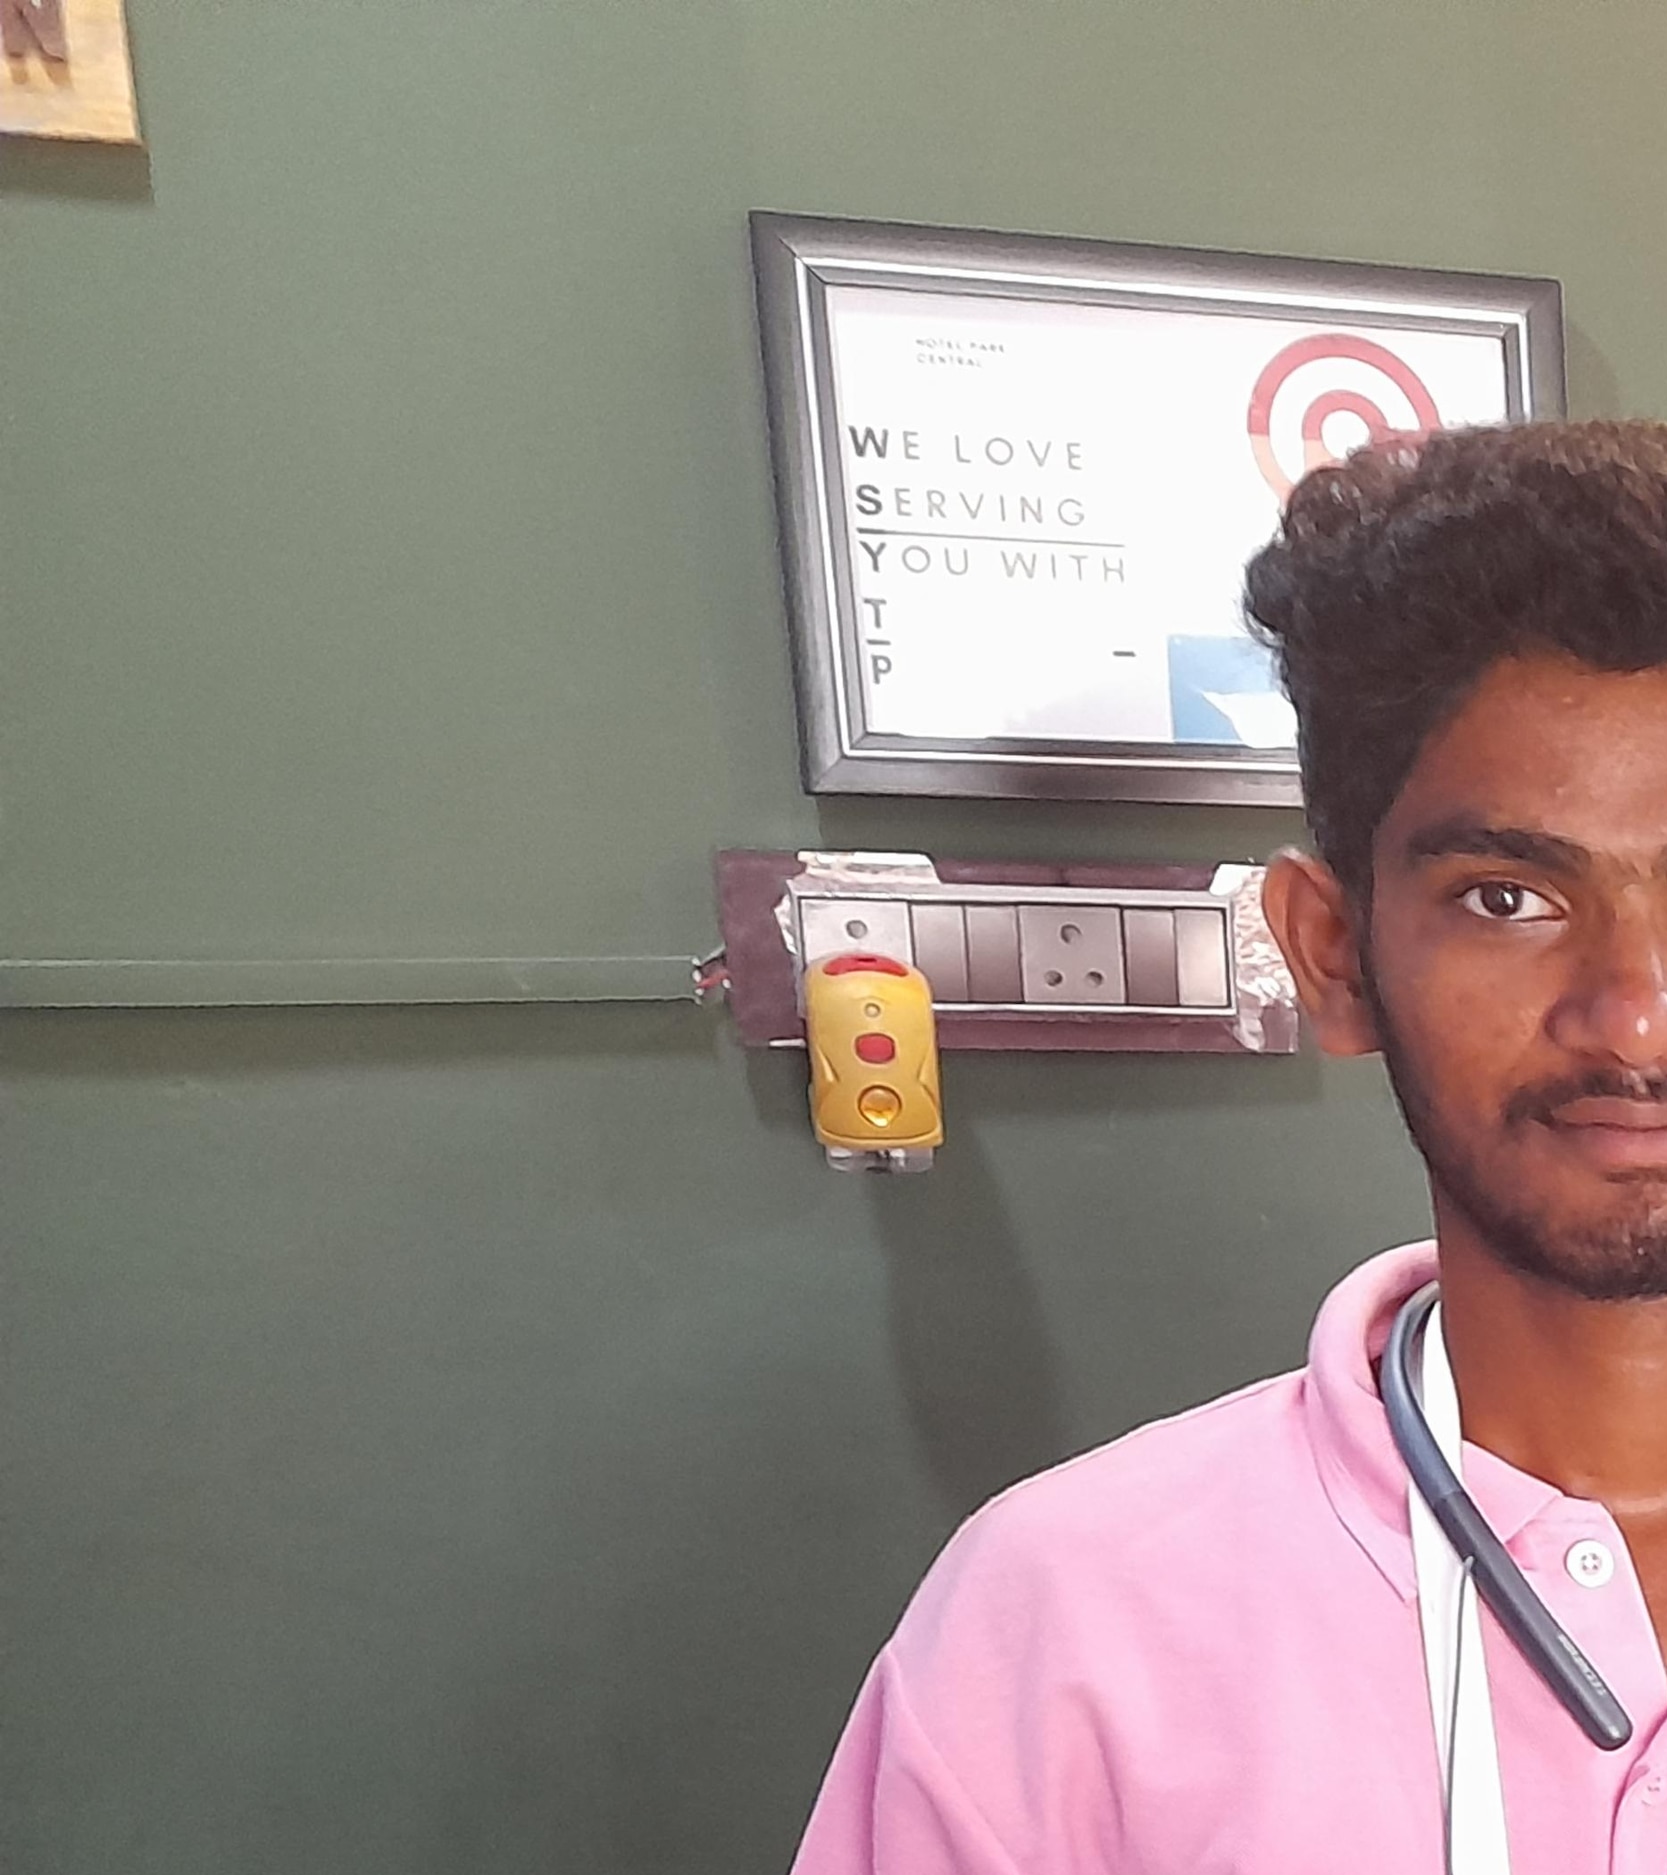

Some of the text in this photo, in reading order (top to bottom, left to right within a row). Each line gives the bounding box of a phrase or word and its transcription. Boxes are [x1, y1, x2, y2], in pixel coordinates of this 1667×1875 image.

[848, 425, 1083, 470] WE LOVE
[855, 483, 1085, 526] SERVING
[859, 540, 1125, 583] YOU WITH
